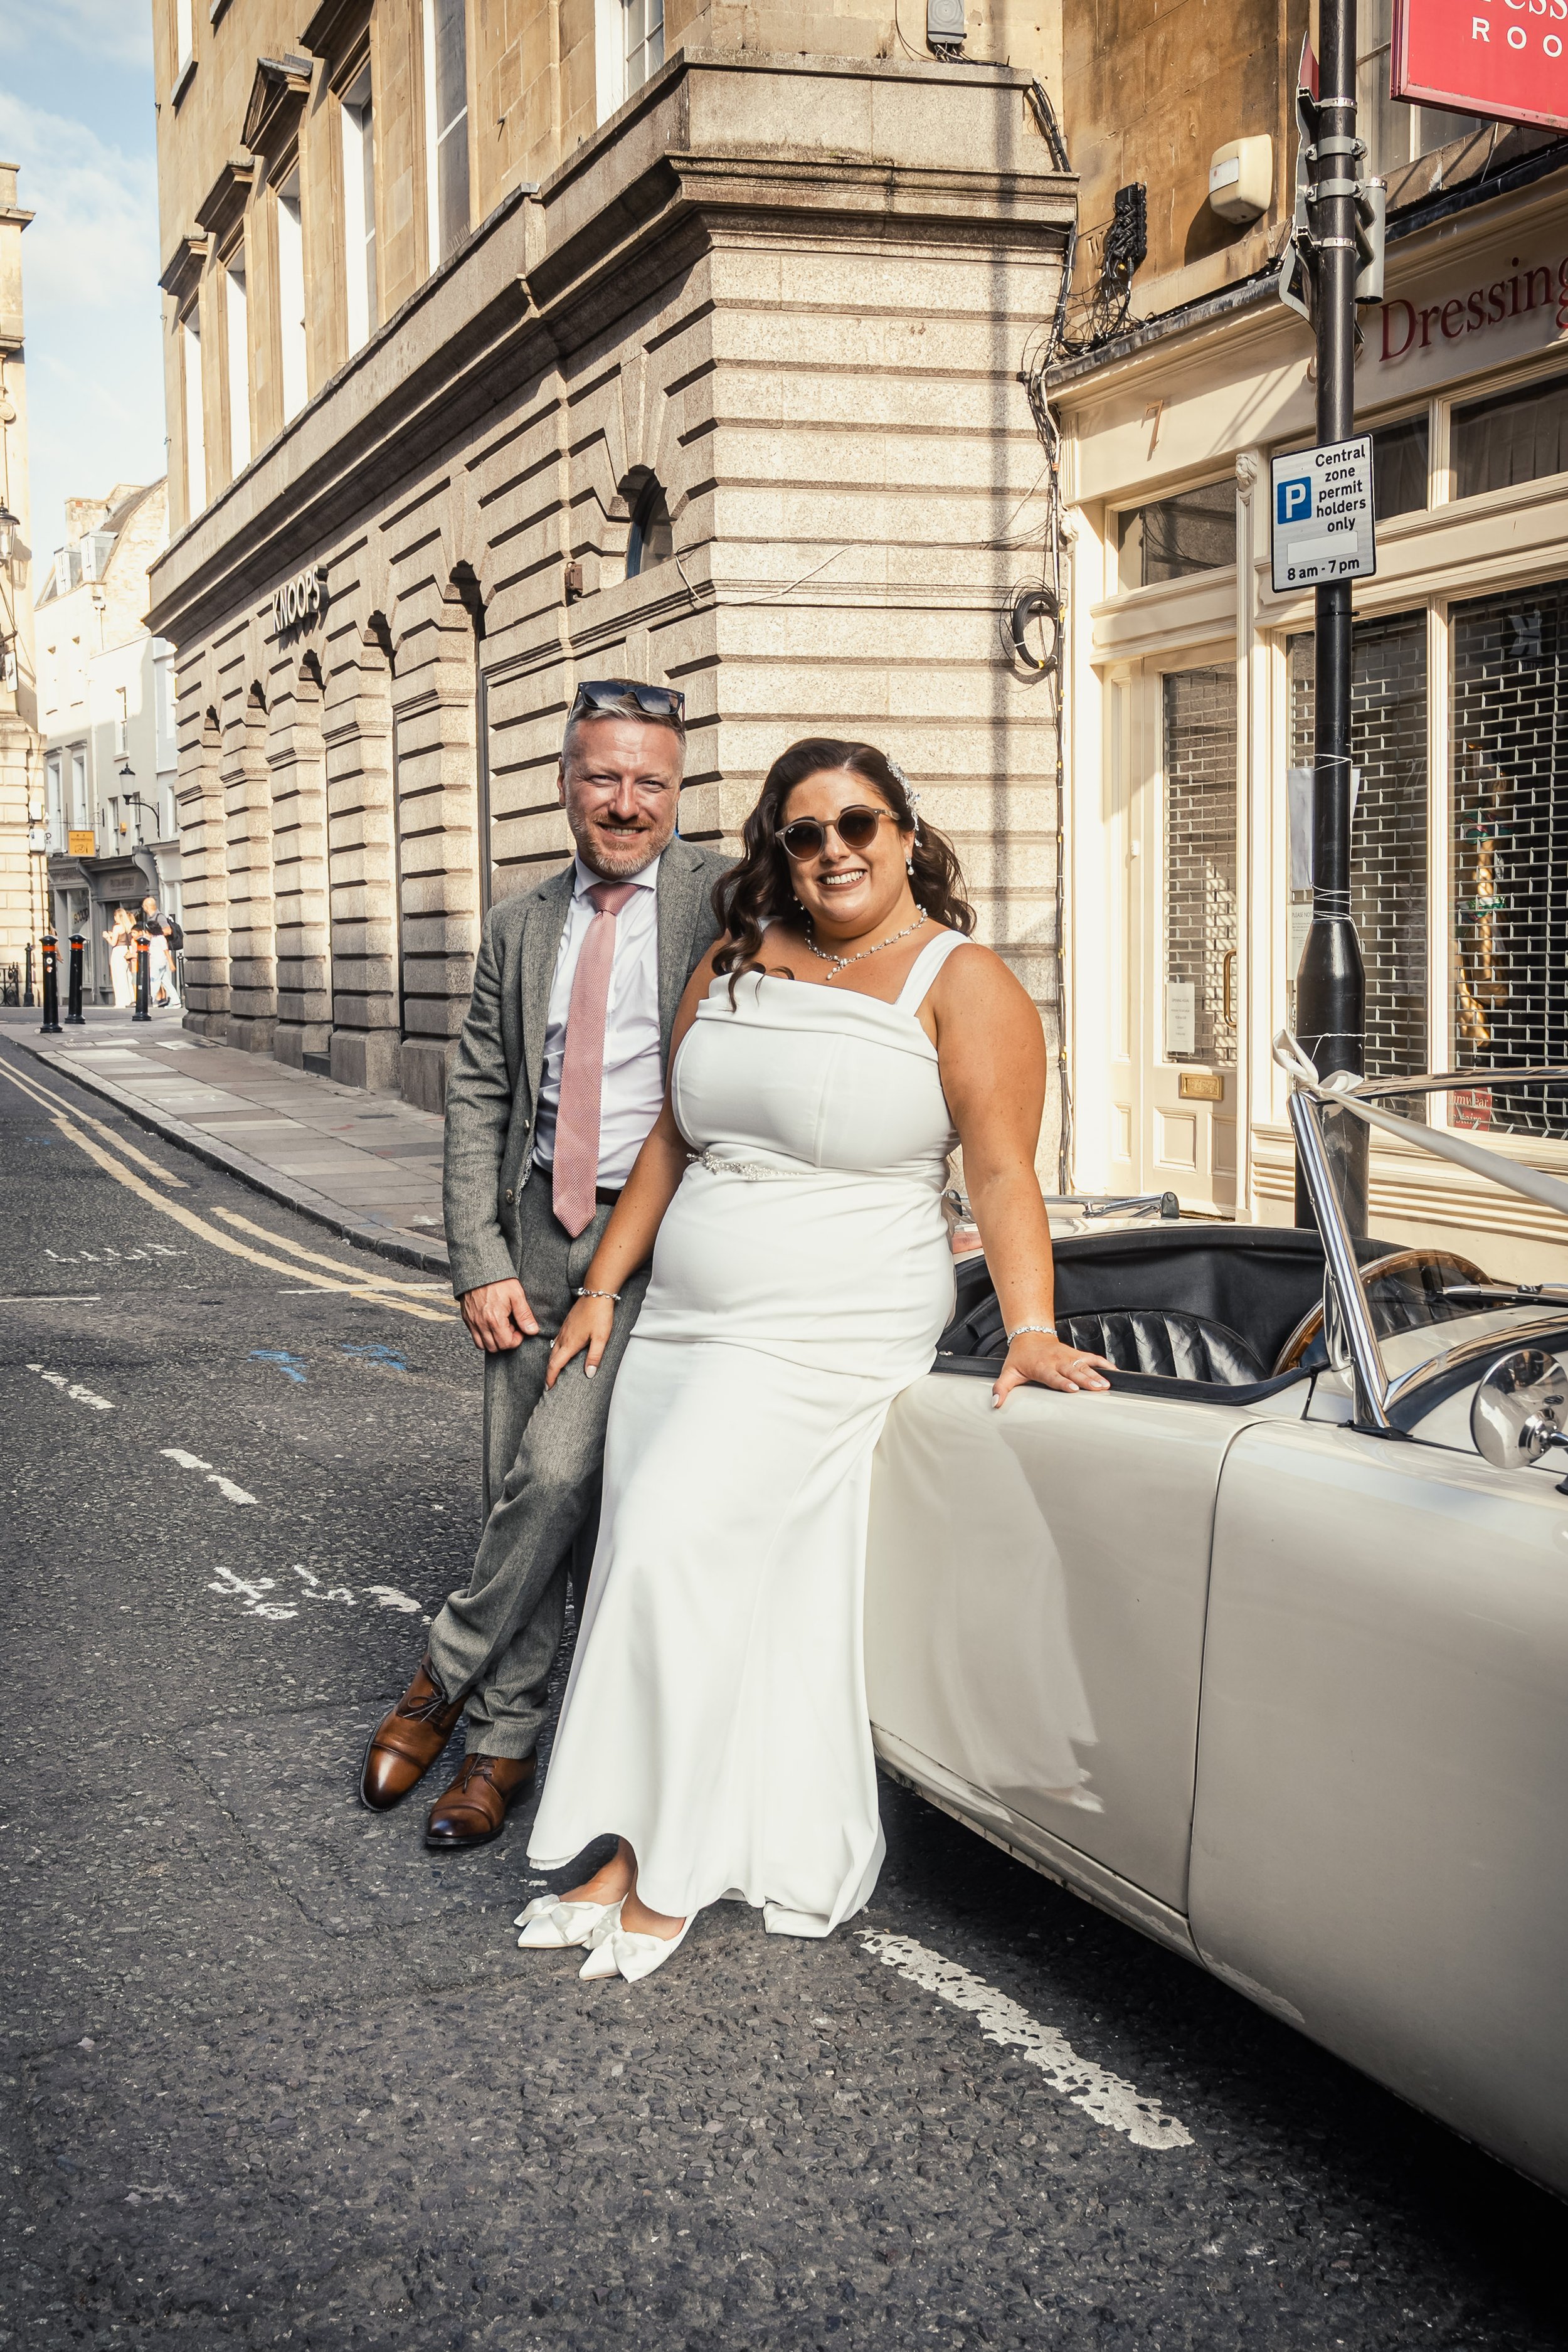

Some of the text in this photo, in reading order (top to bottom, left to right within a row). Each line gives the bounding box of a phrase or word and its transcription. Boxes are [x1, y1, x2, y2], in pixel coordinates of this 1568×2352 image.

[1315, 444, 1365, 467] Central
[1325, 467, 1355, 482] zone
[1285, 483, 1306, 519] P
[1319, 480, 1363, 502] permit
[1316, 498, 1366, 518] holders
[1327, 517, 1356, 532] only
[272, 564, 320, 634] KNOOPS
[1450, 1092, 1489, 1108] imwear
